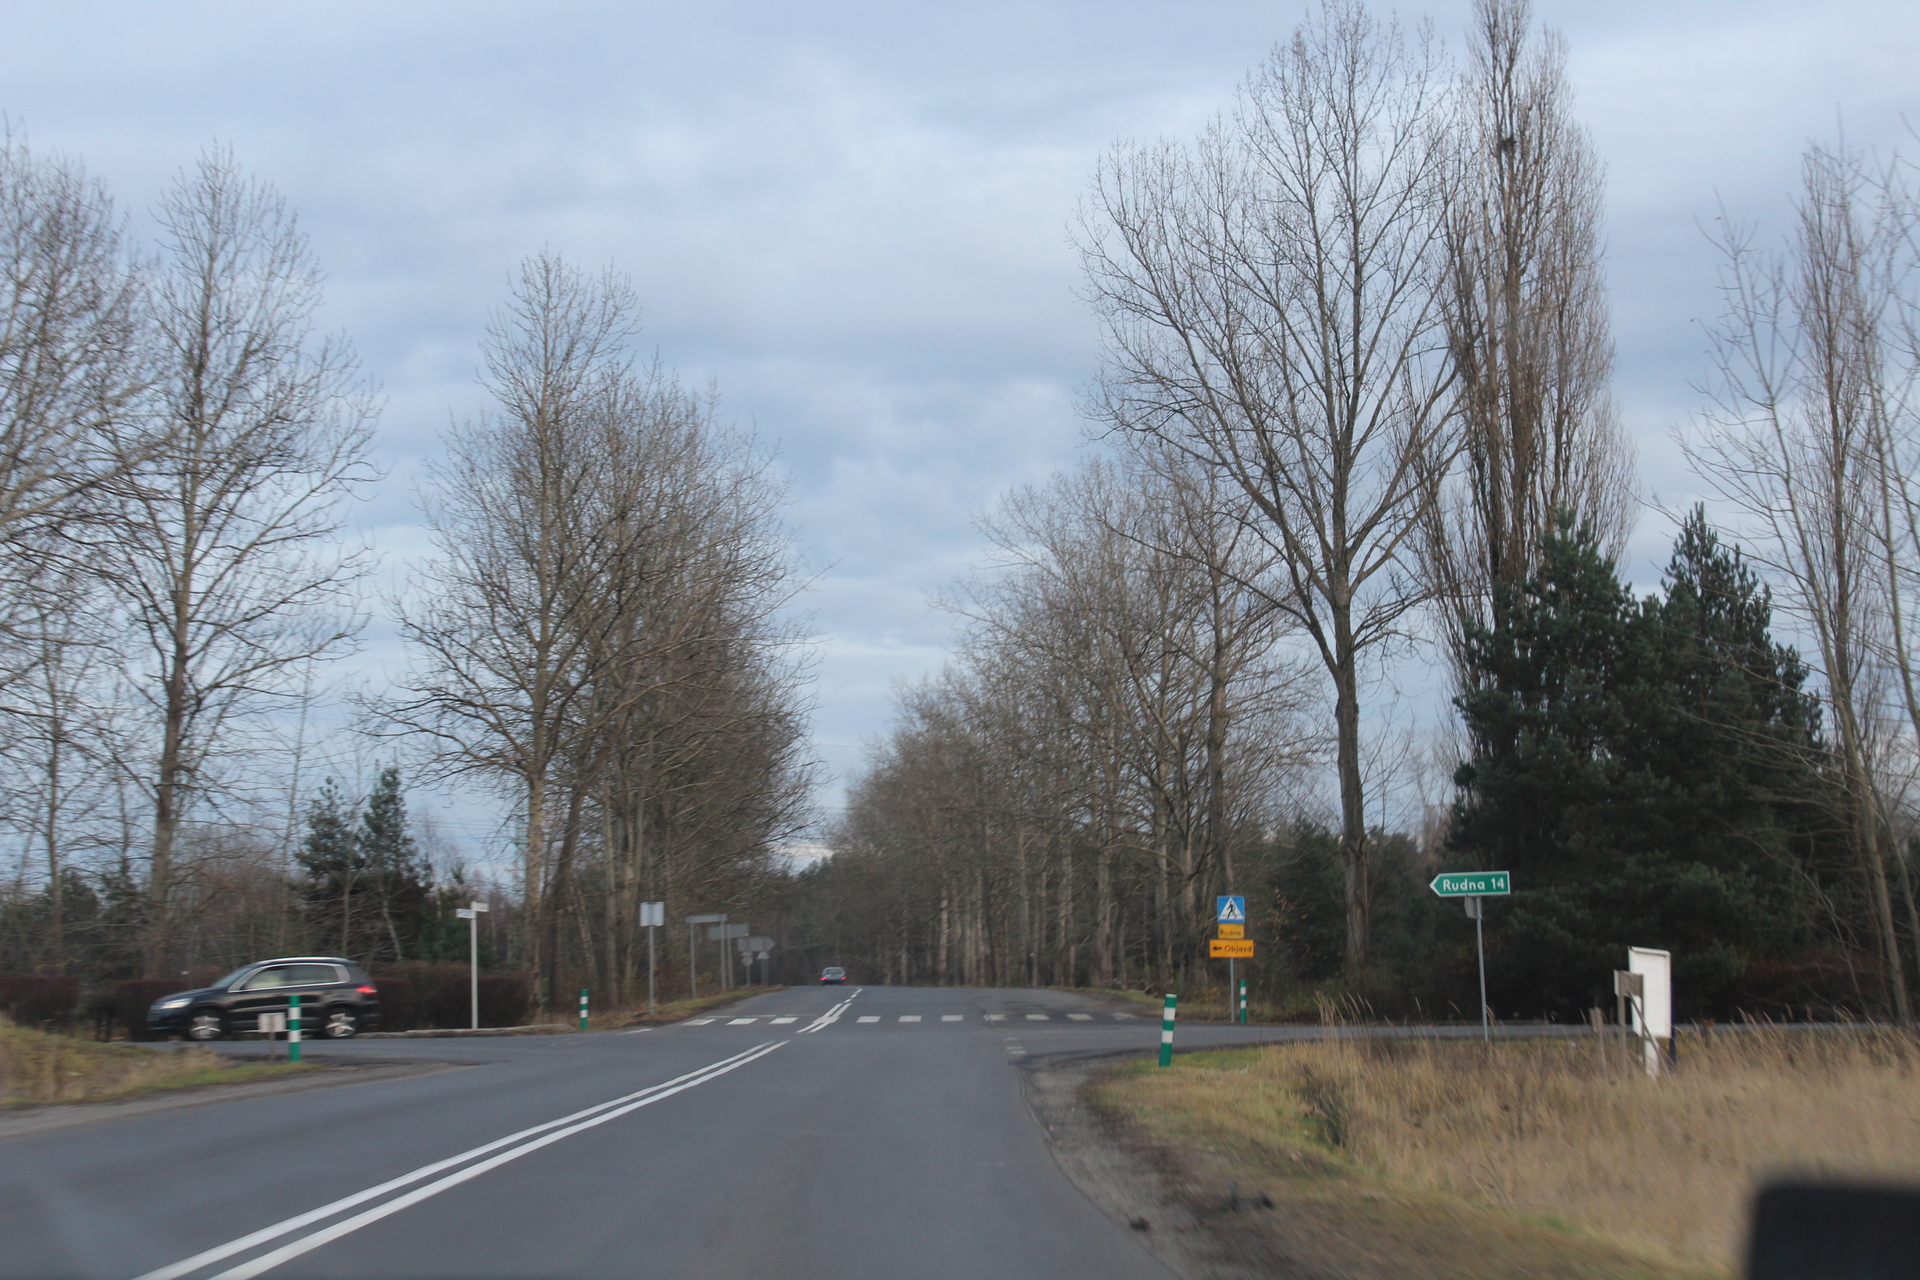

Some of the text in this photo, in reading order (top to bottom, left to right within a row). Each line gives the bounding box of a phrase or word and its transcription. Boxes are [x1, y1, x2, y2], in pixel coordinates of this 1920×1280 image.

[1442, 877, 1505, 892] Rudna 14
[1224, 944, 1253, 954] Objazd
